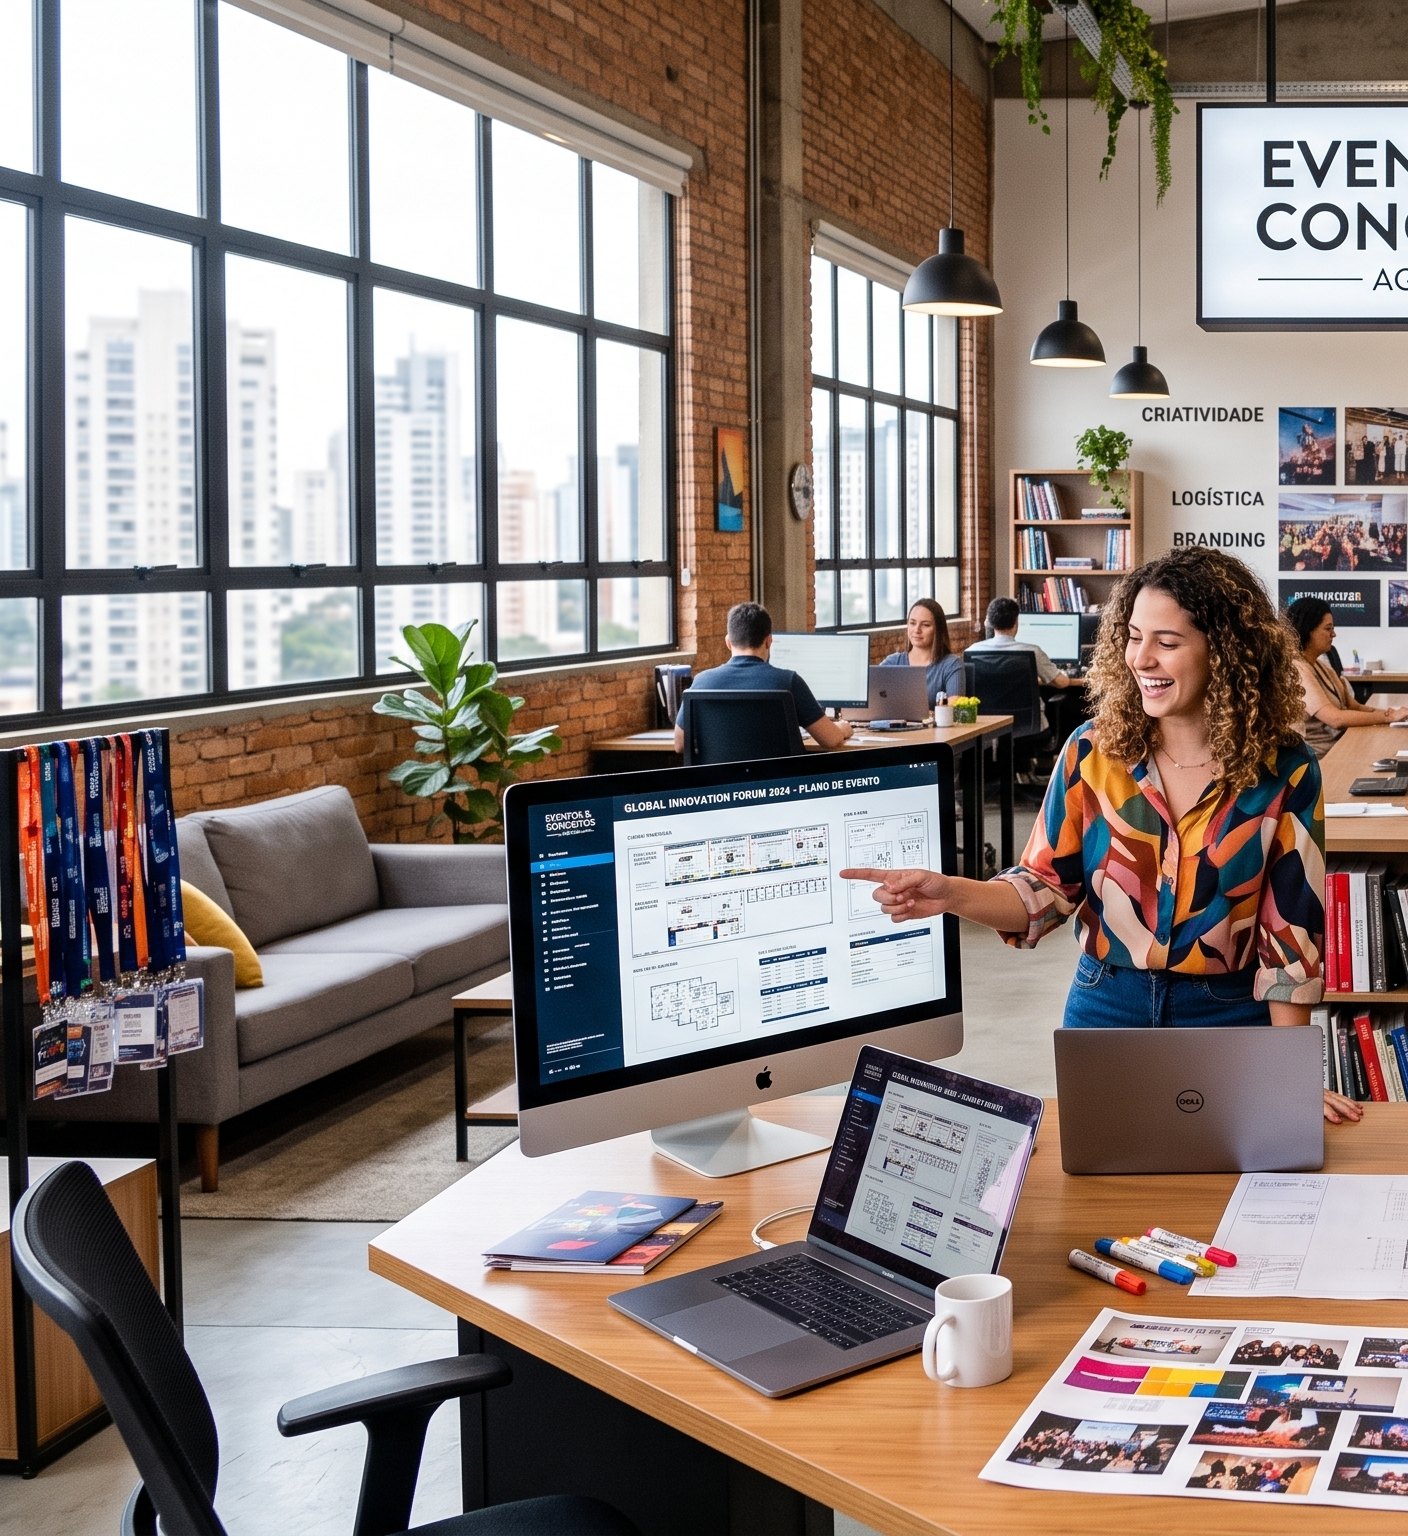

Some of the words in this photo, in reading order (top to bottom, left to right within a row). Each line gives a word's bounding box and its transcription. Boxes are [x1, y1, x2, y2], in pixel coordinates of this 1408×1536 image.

[1141, 407, 1264, 423] CRIATIVIDADE
[1172, 487, 1265, 507] LOGÍSTICA
[1173, 532, 1266, 548] BRANDING
[624, 800, 667, 813] GLOBAL
[668, 793, 731, 809] INNOVATION
[733, 789, 767, 801] FORUM
[768, 786, 791, 797] 2024
[799, 782, 830, 793] PLANO
[831, 779, 844, 790] DE
[845, 776, 880, 788] EVENTO
